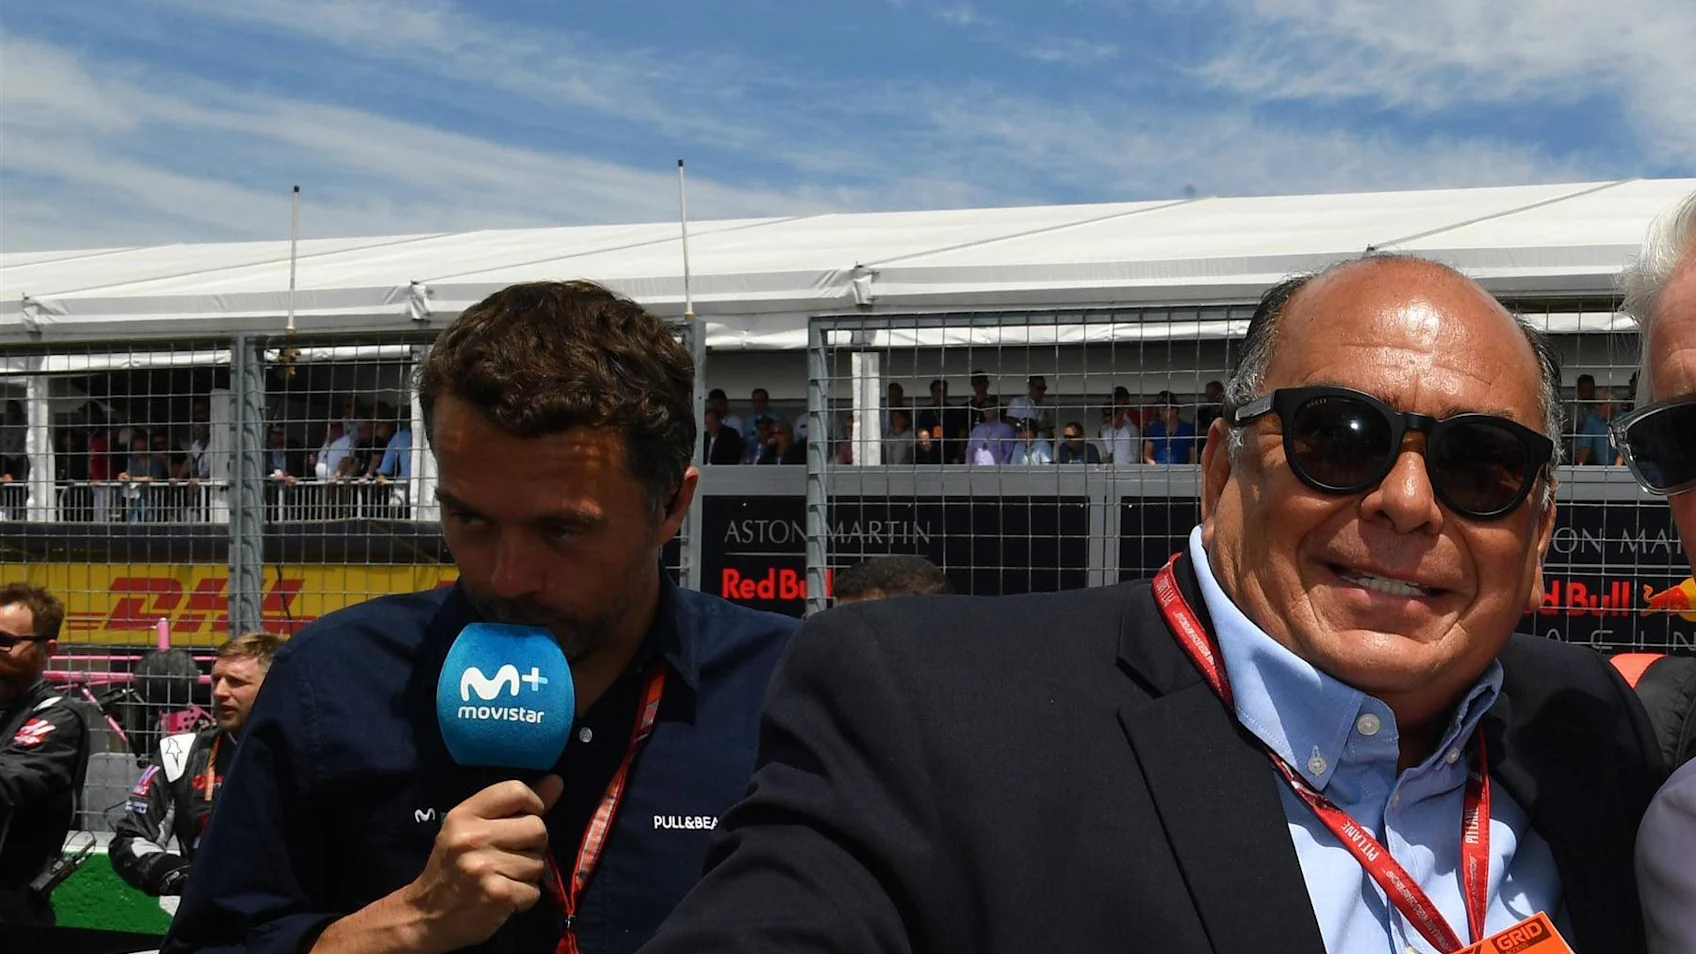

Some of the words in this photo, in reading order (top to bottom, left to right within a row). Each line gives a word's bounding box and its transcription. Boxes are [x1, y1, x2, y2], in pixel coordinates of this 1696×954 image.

[825, 519, 931, 545] MARTIN
[721, 567, 775, 600] Red
[457, 704, 545, 724] movistar
[1341, 820, 1367, 850] LANE
[1360, 844, 1380, 862] PIT
[1496, 921, 1543, 951] GRID
